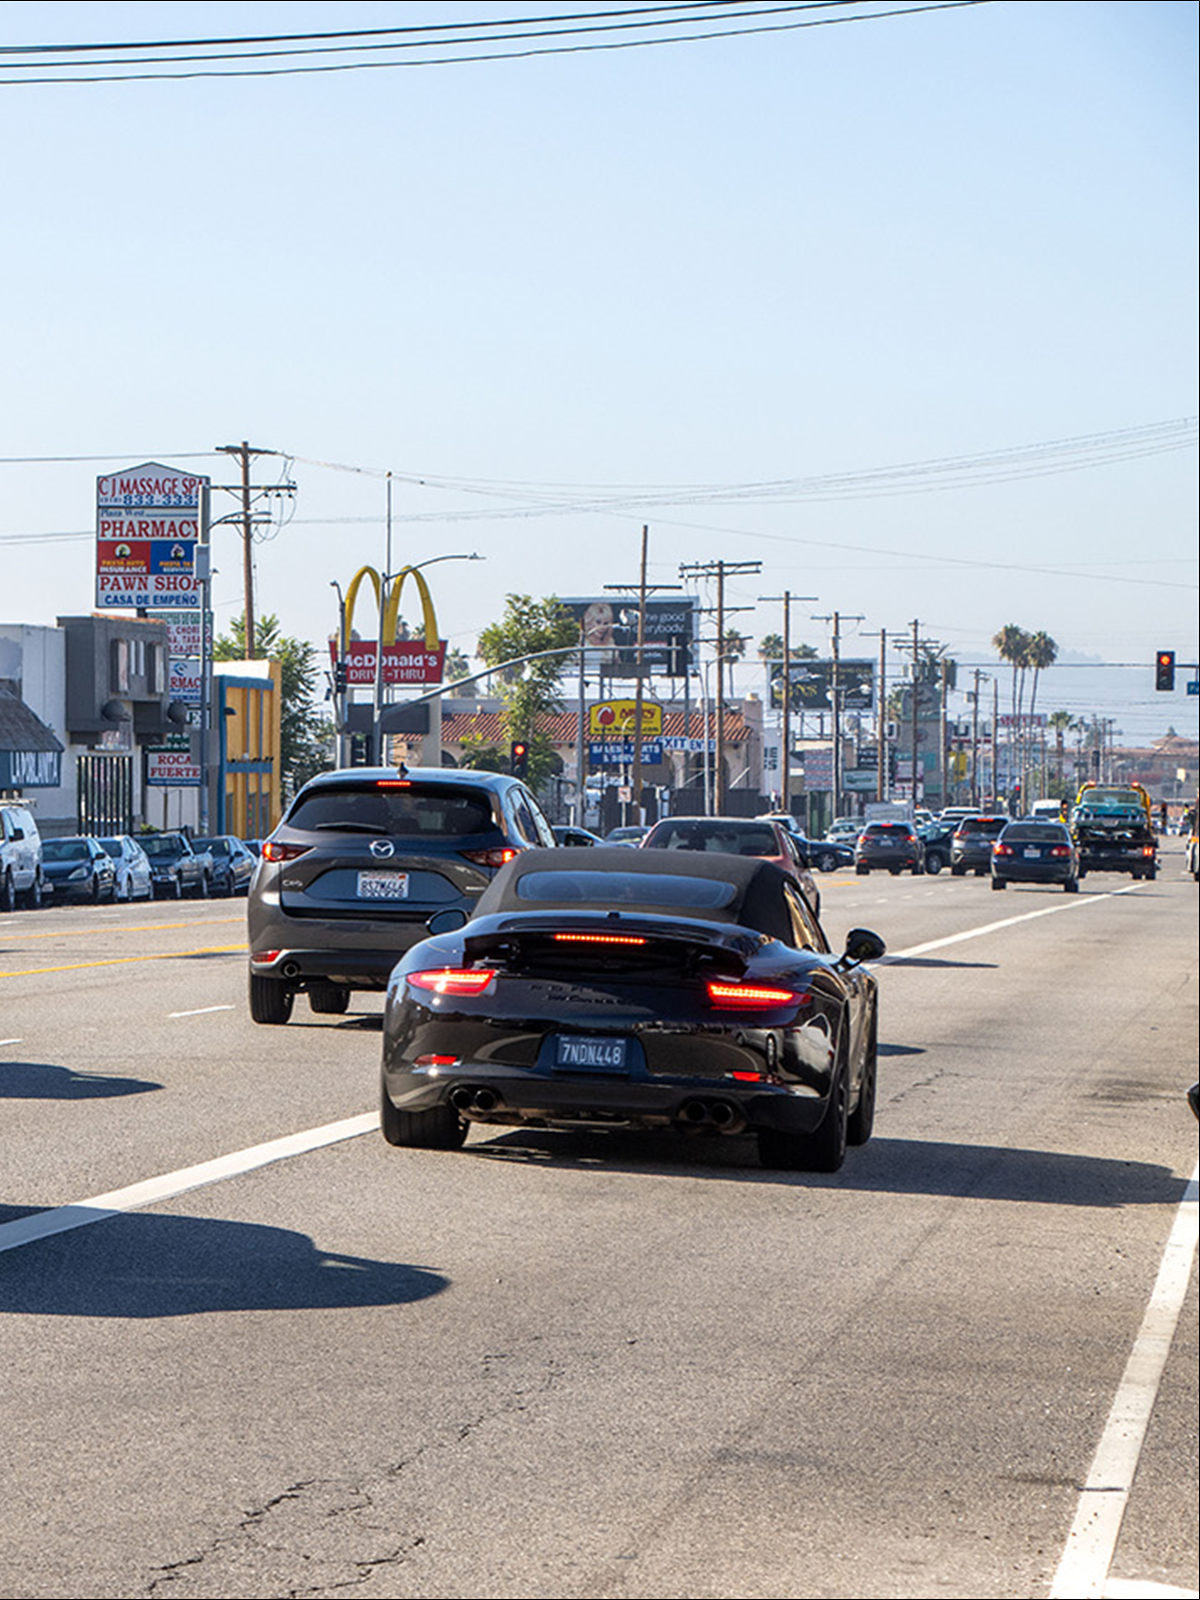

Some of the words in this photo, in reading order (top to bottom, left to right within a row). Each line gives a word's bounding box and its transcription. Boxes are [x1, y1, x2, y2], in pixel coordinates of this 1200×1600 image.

[99, 478, 109, 495] C
[119, 478, 179, 495] MASSAGE
[100, 520, 199, 538] PHARMACY
[100, 577, 149, 591] PAWN
[154, 576, 201, 591] SHOP
[105, 594, 134, 605] CASA
[136, 594, 151, 605] DE
[153, 592, 198, 605] EMPEÑO
[176, 626, 210, 635] CHORIO
[182, 636, 212, 644] TASAO
[158, 755, 191, 766] ROCA
[150, 767, 200, 778] FUERTE
[562, 1044, 622, 1064] 7NDN448
